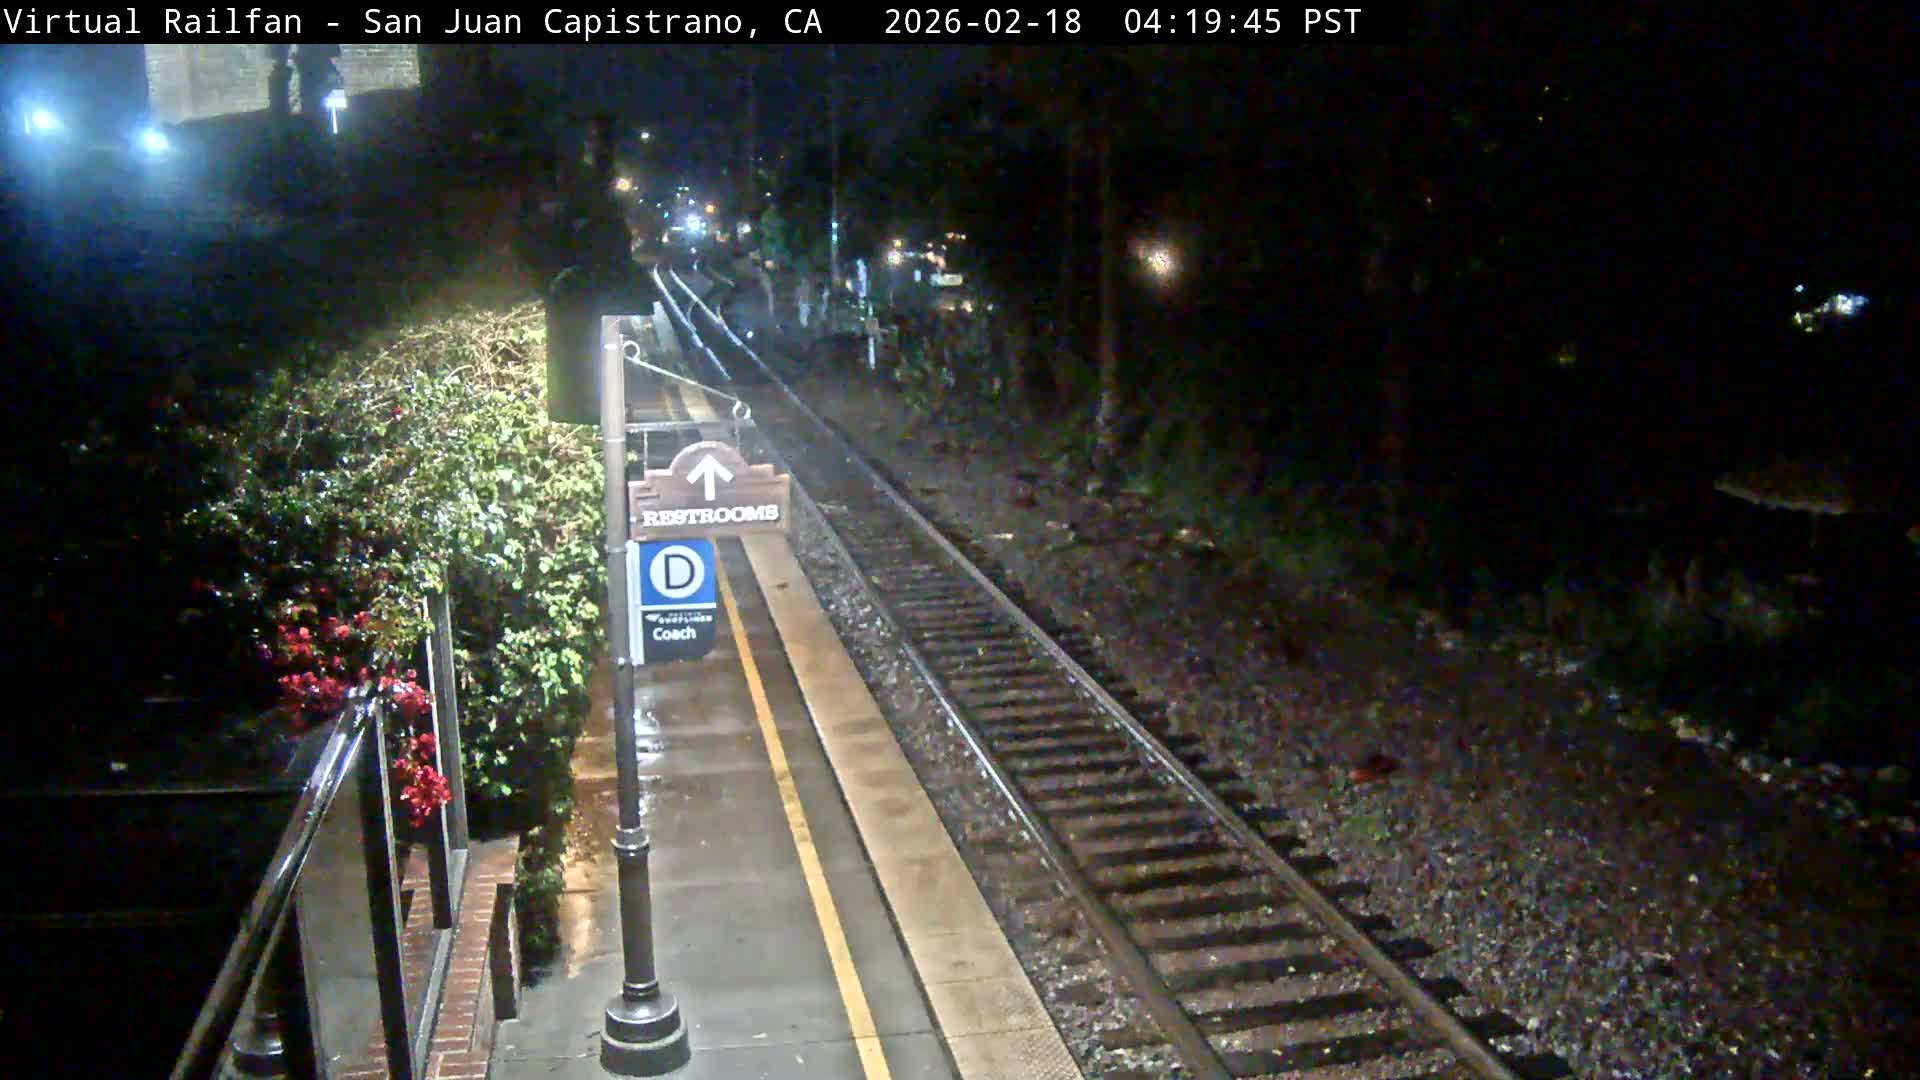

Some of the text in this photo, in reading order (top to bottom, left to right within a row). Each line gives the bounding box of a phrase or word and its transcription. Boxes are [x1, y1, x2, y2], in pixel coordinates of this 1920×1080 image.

[642, 505, 779, 527] RESTROOMS
[664, 554, 695, 590] D
[652, 626, 697, 641] Coach
